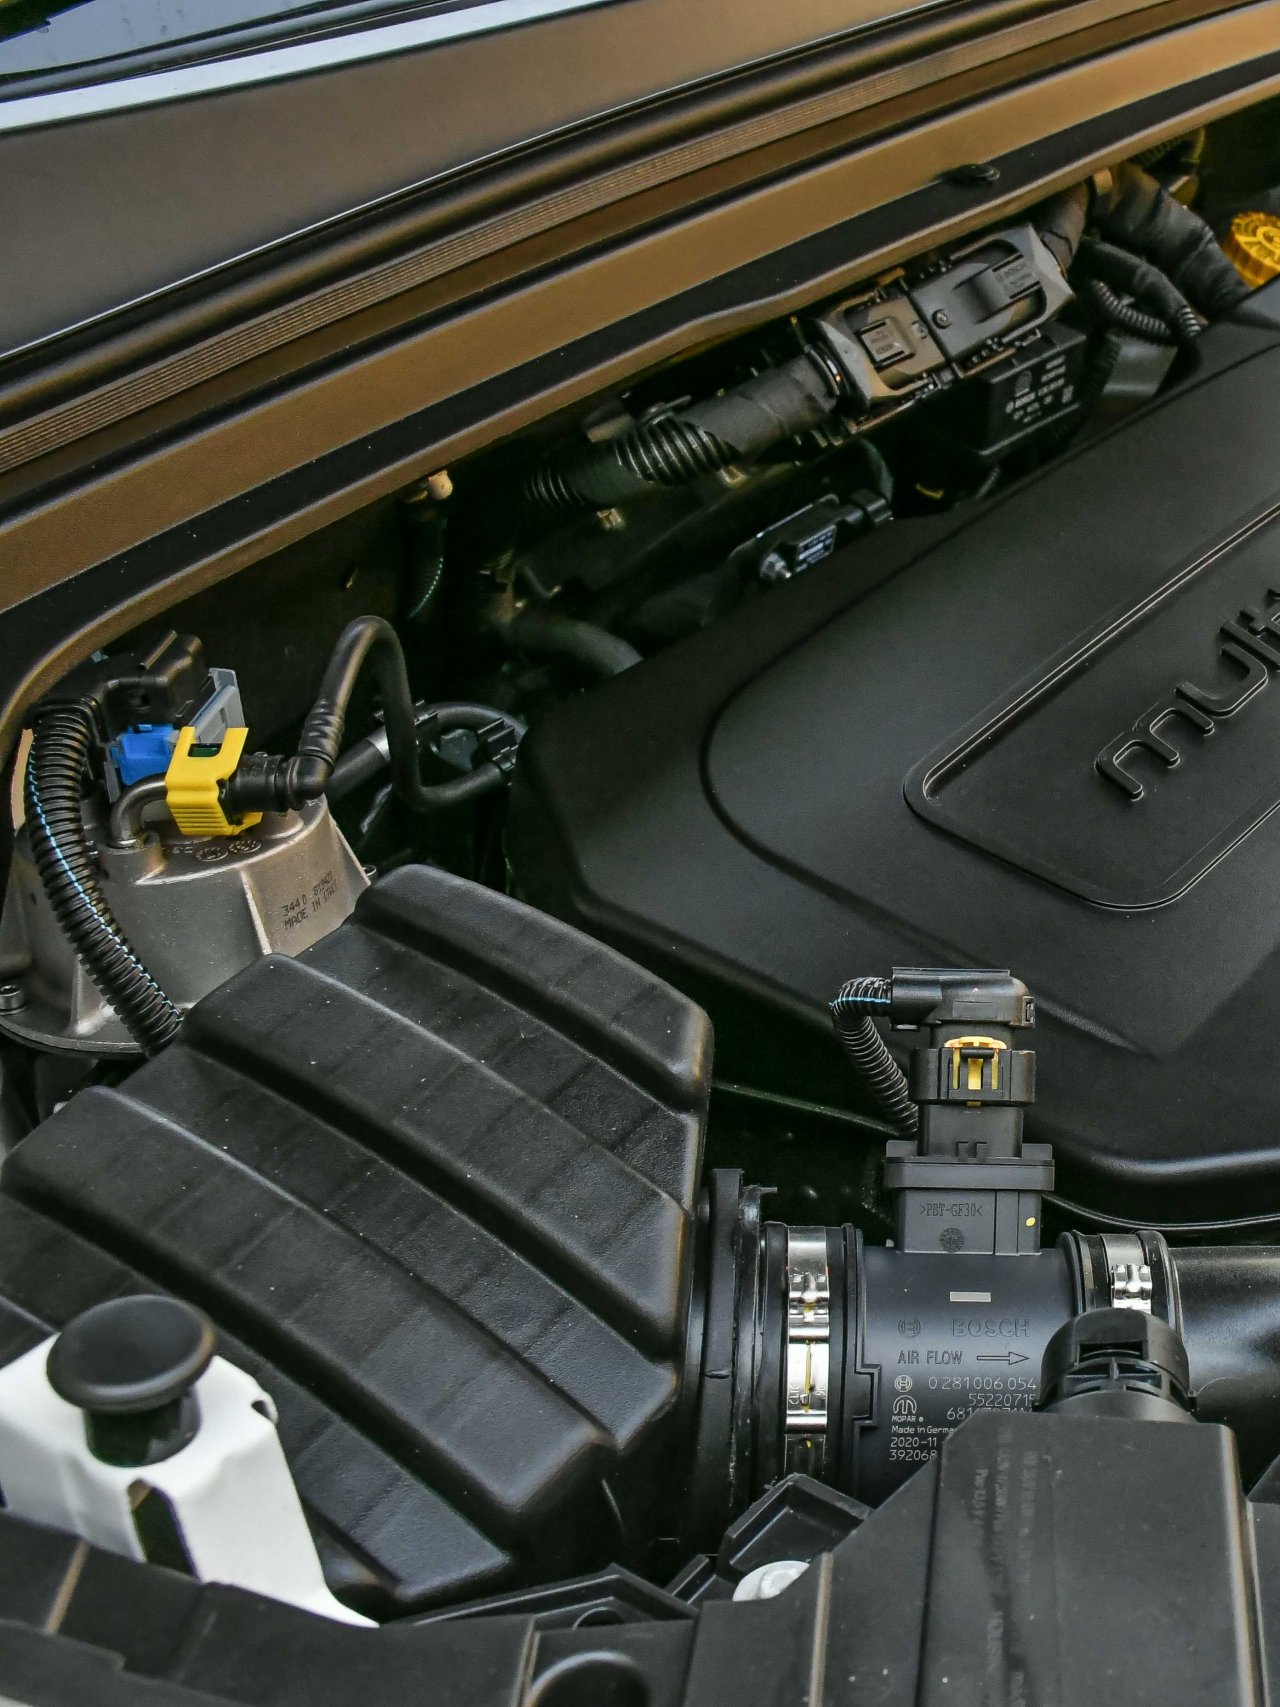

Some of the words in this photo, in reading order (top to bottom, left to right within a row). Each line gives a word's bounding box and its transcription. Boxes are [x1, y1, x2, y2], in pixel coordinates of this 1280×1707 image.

[952, 1319, 1031, 1338] BOSCH
[897, 1350, 920, 1365] AIR
[926, 1350, 963, 1365] FLOW
[1007, 1377, 1038, 1391] 054
[891, 1415, 916, 1423] MOPAR
[891, 1425, 915, 1434] Made
[916, 1425, 926, 1434] in
